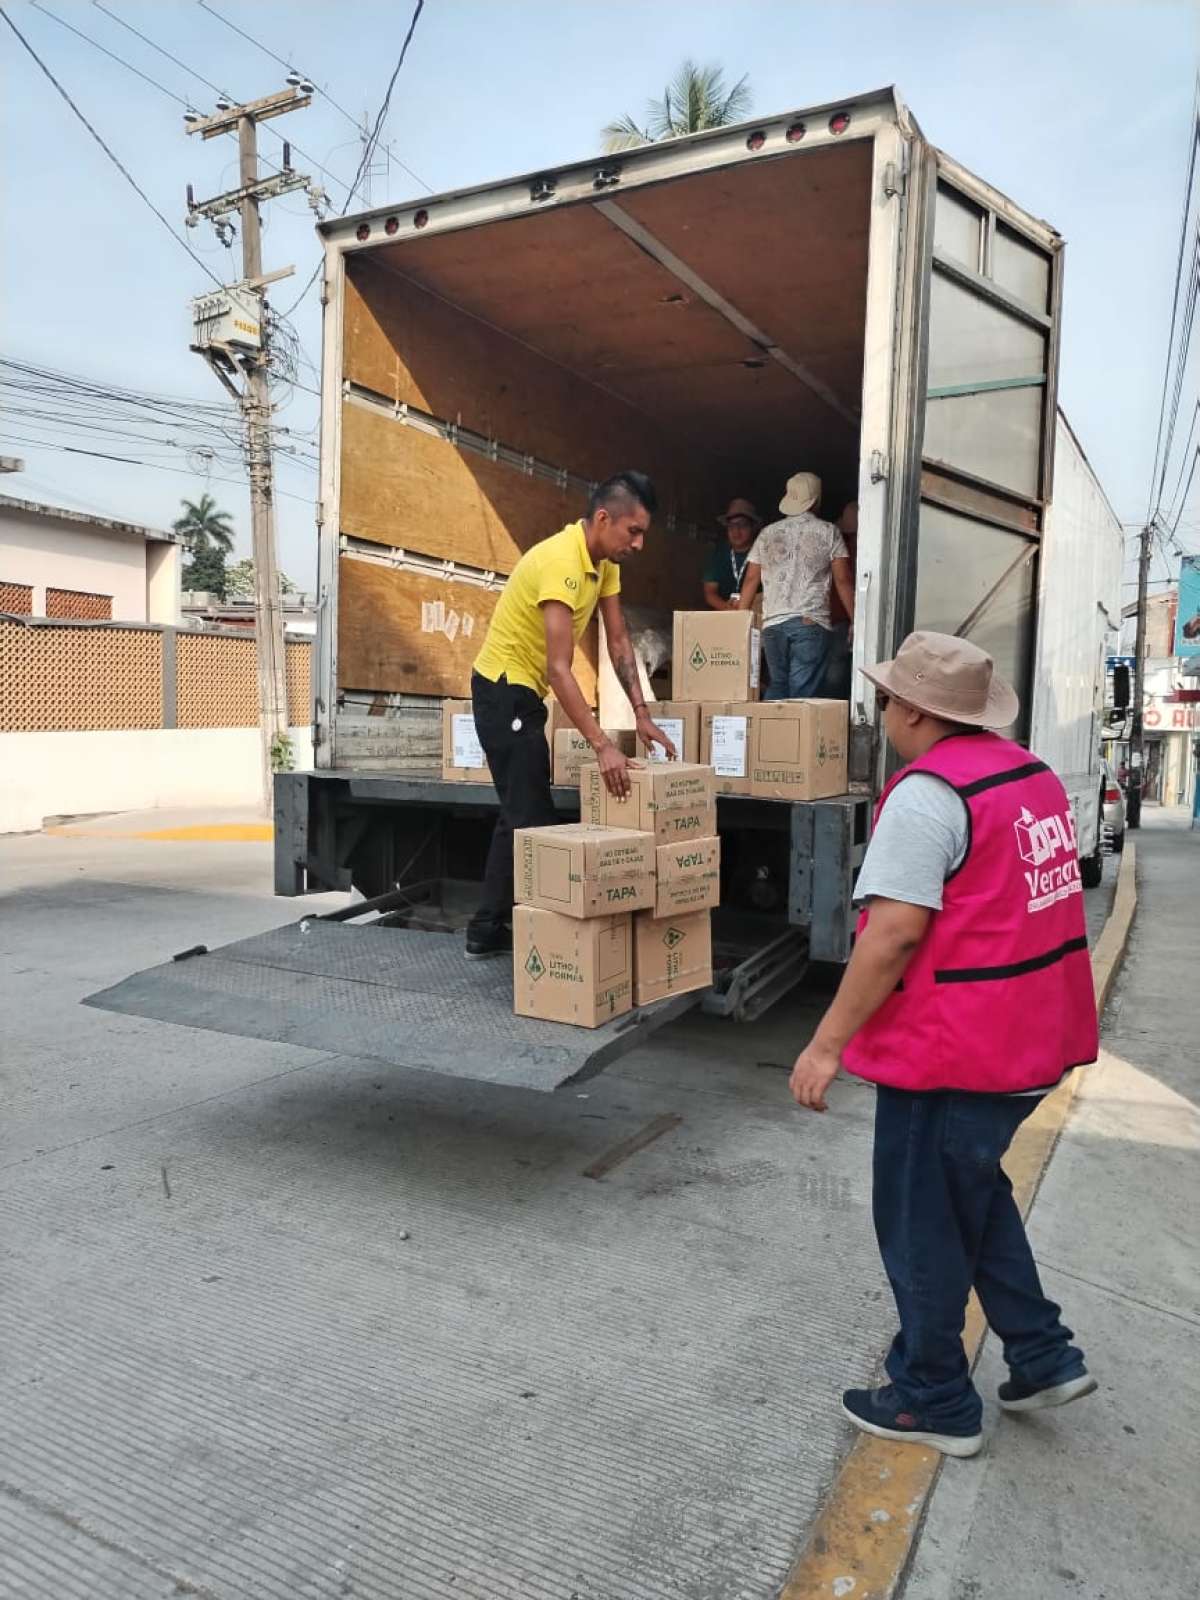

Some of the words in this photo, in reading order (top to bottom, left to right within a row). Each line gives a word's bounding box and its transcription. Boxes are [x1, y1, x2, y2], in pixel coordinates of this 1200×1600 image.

[674, 816, 700, 831] TAPA
[675, 852, 704, 868] TAPA
[606, 885, 637, 901] TAPA
